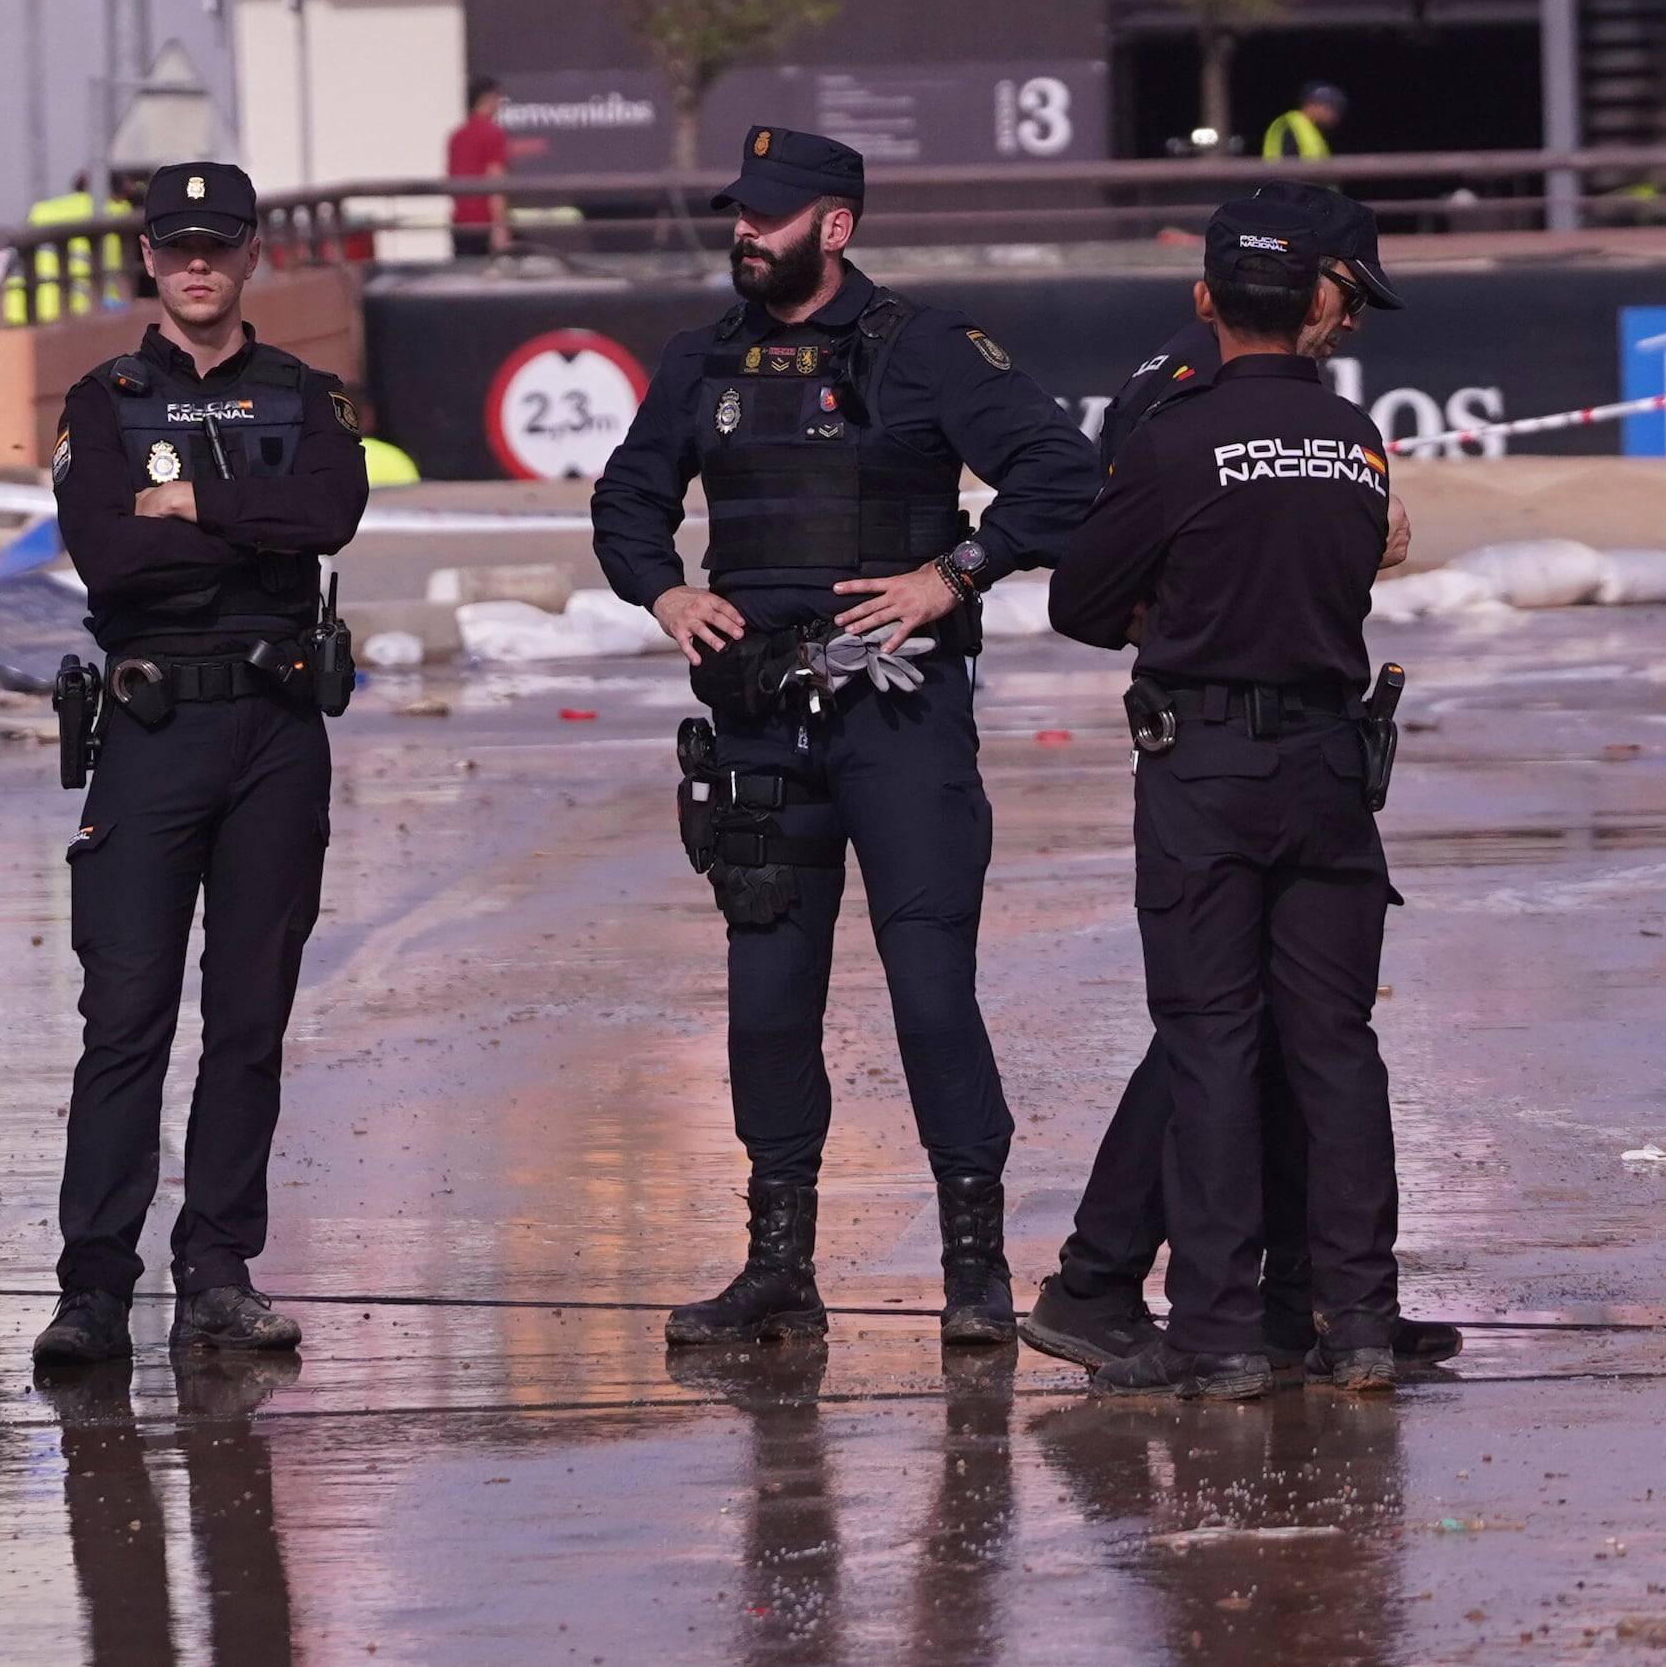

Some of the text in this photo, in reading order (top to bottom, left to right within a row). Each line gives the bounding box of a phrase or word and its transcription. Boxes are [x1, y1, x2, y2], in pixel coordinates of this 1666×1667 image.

[1016, 76, 1074, 157] 3
[1239, 234, 1278, 245] POLICIA
[1239, 241, 1288, 253] NACIONAL
[1214, 437, 1367, 467] POLICIA
[1218, 458, 1388, 498] NACIONAL
